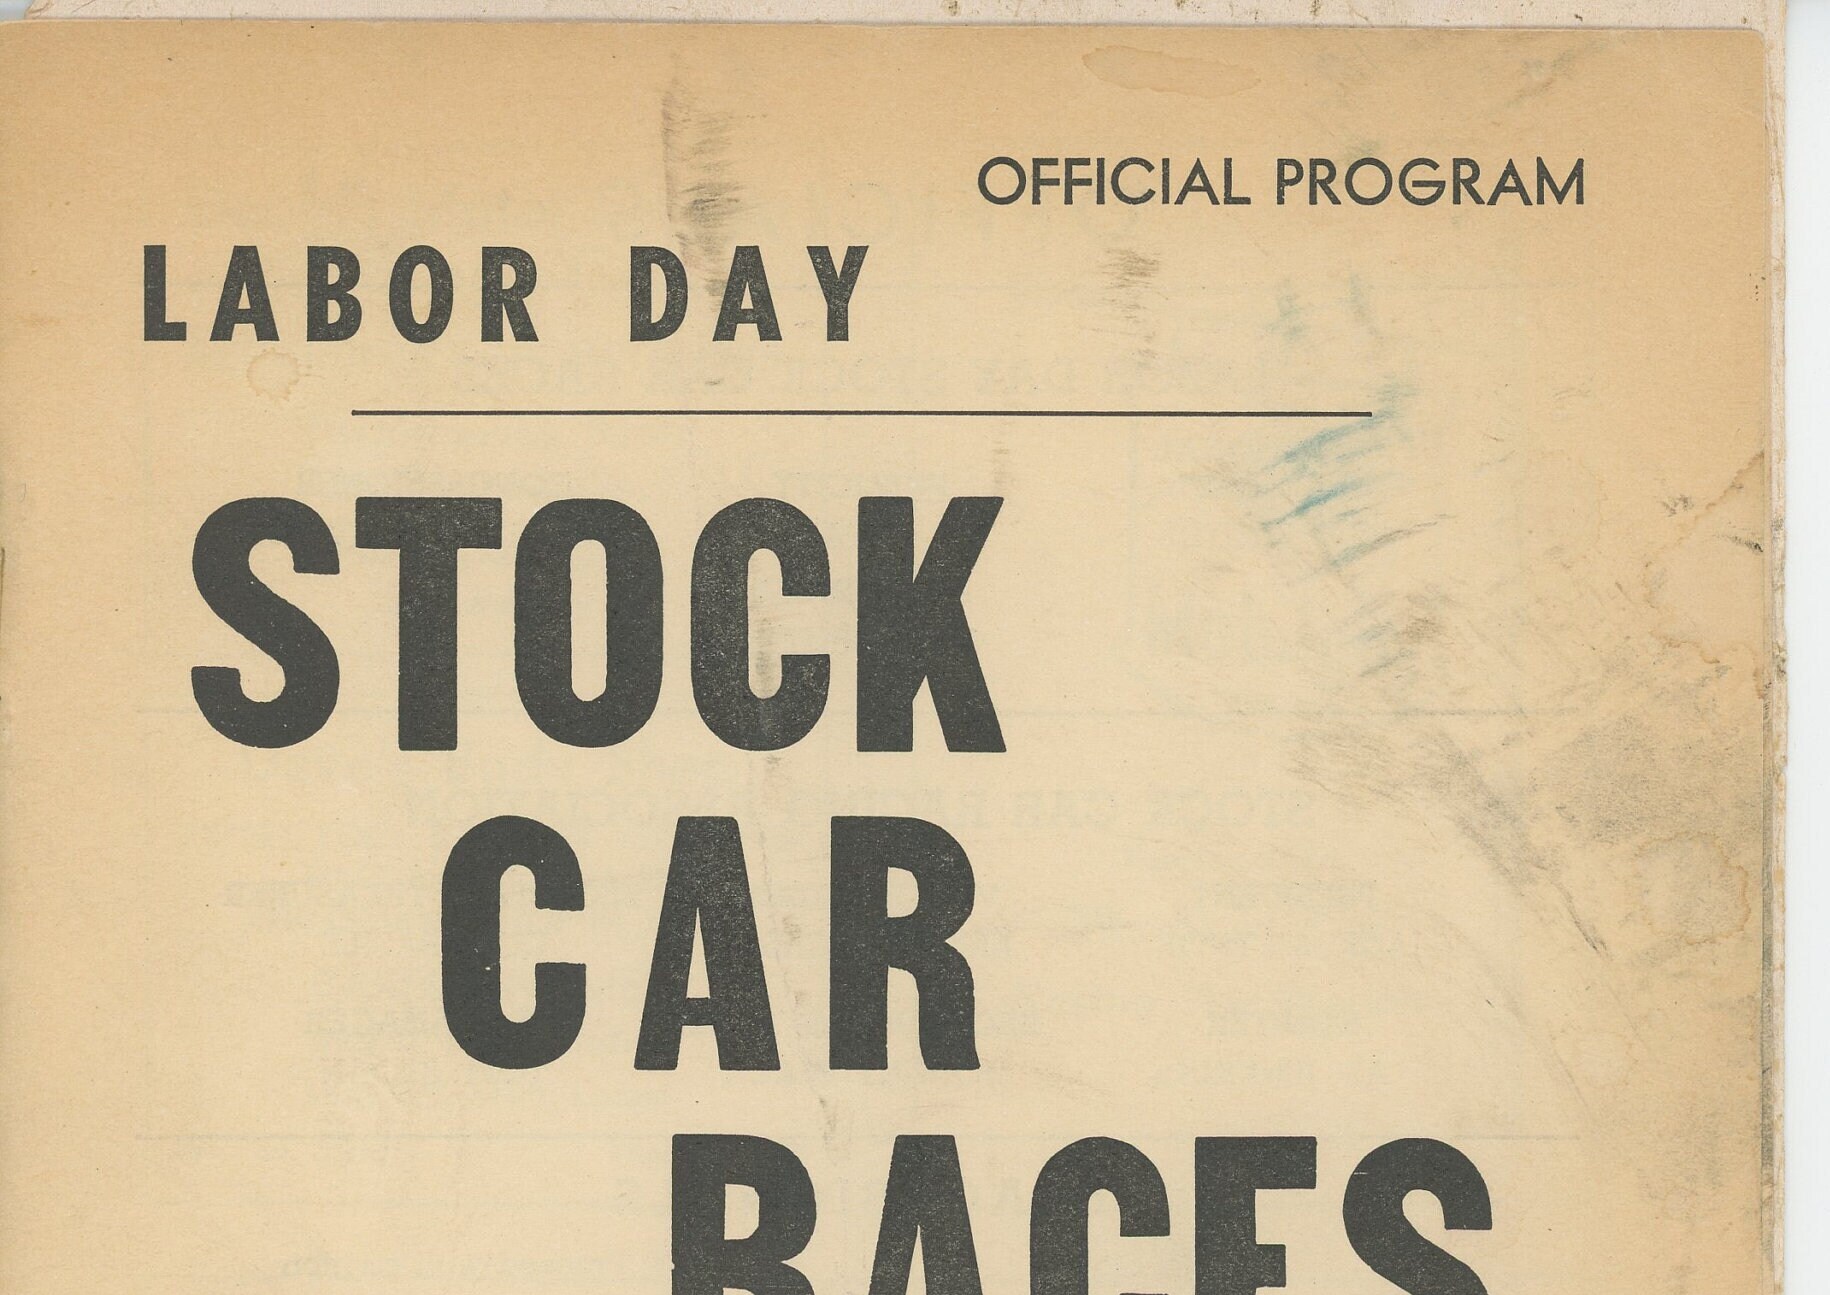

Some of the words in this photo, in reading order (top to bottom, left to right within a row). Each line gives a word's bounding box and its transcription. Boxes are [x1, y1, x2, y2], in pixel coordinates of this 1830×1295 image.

[978, 157, 1250, 207] OFFICIAL
[1276, 157, 1584, 207] PROGRAM
[144, 244, 539, 344] LABOR
[630, 245, 870, 342] DAY
[191, 496, 1007, 753] STOCK
[441, 815, 981, 1071] CAR
